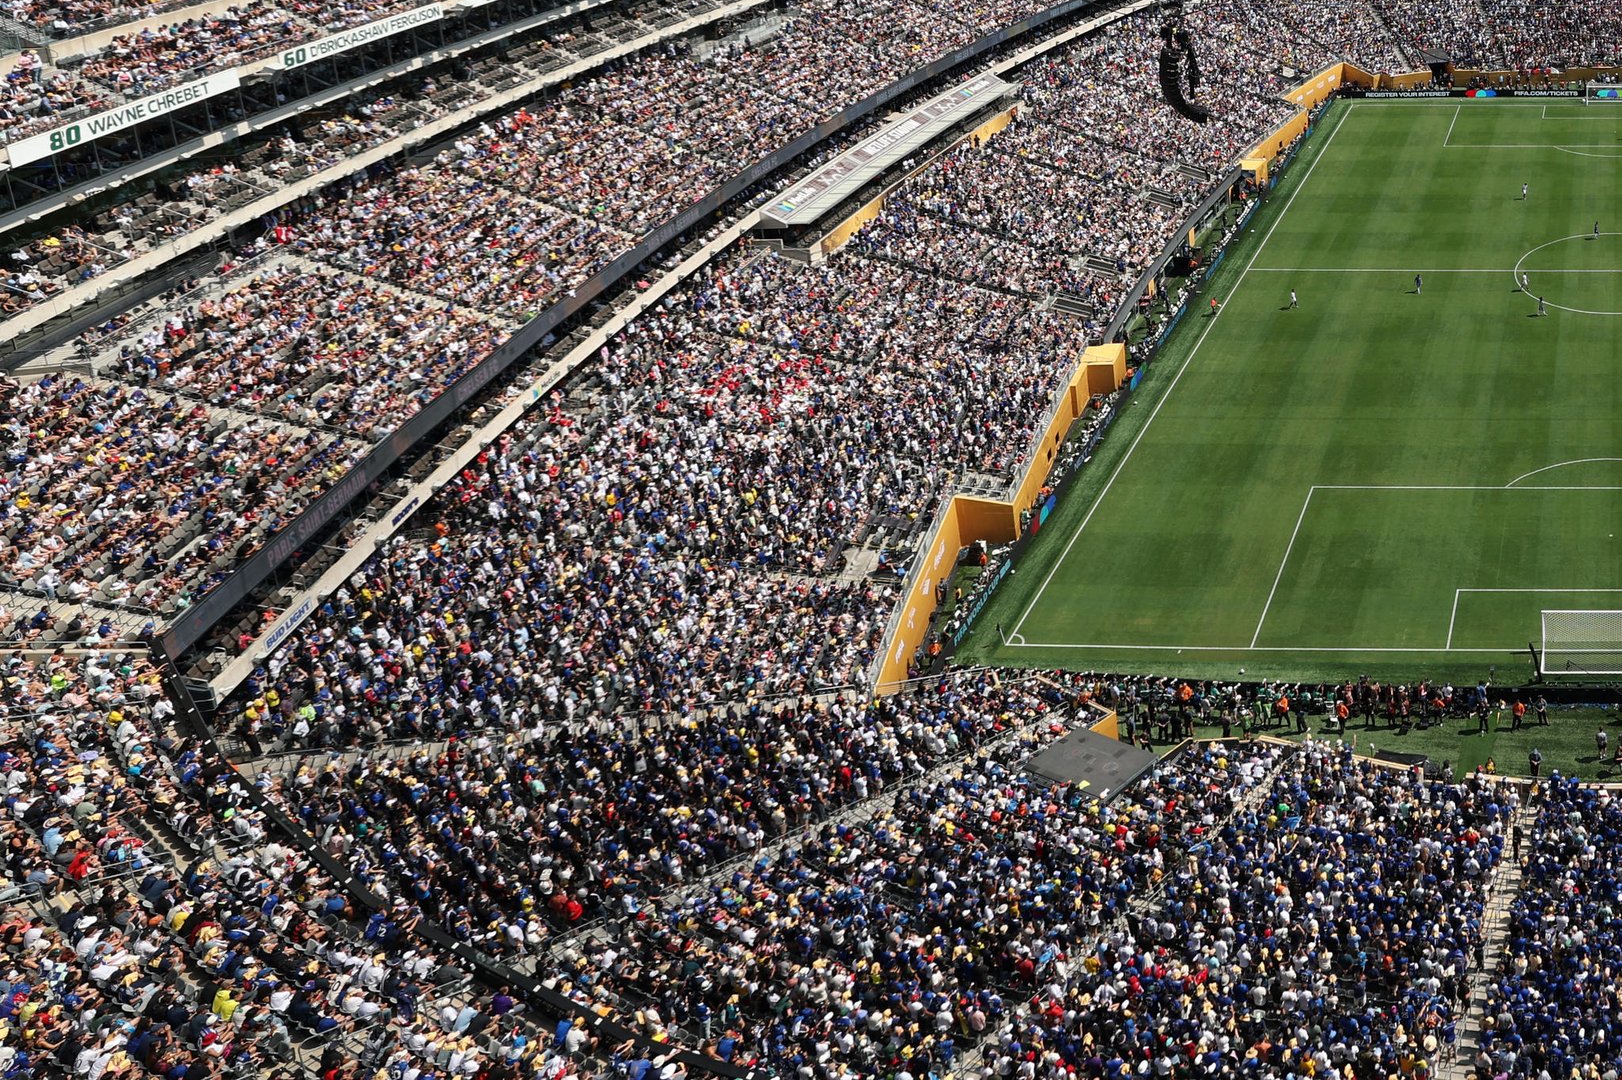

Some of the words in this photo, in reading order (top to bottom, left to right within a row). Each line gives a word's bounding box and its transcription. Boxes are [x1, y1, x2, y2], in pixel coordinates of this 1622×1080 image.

[284, 48, 306, 67] 60
[310, 24, 390, 58] D'BRICKASHAW
[388, 6, 440, 33] FERGUSON
[50, 125, 81, 151] 80
[87, 103, 146, 135] WAYNE
[147, 81, 209, 114] CHREBET
[862, 134, 893, 156] METLIFE
[891, 119, 921, 140] STADIUM
[793, 187, 817, 202] MetLife
[266, 534, 298, 568] PARIS
[299, 469, 367, 543] SAINT-GERMAIN
[265, 627, 285, 649] BUD
[284, 601, 311, 635] LIGHT
[953, 624, 968, 647] FIFA
[966, 592, 988, 627] WORLD
[987, 576, 1000, 596] CUP
